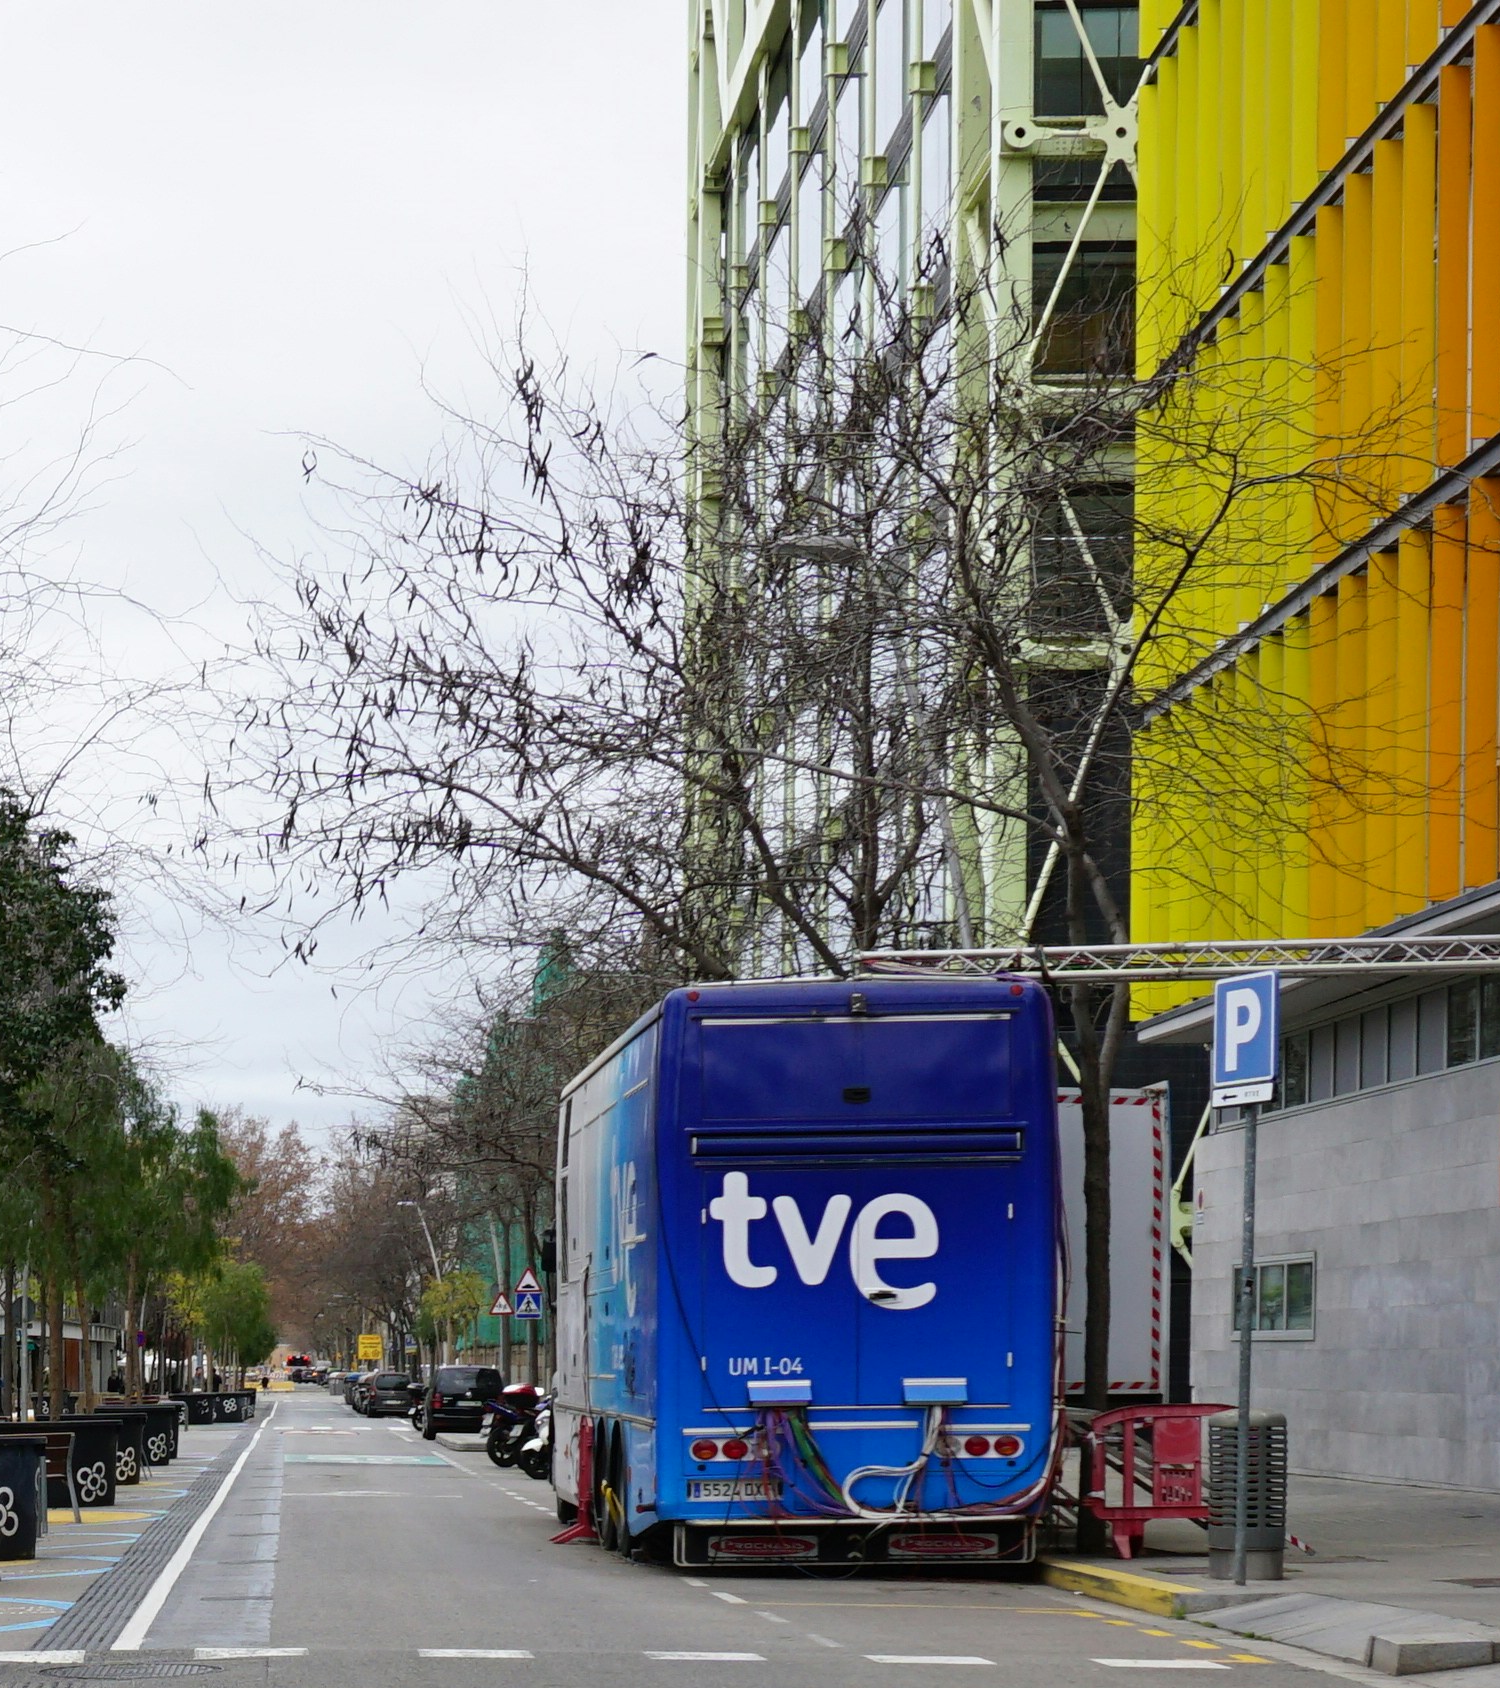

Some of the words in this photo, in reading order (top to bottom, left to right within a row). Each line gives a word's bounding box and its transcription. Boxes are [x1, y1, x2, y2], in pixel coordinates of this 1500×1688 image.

[1224, 987, 1261, 1073] P
[709, 1171, 940, 1310] tve
[728, 1356, 759, 1376] UM
[763, 1356, 804, 1376] I-04
[703, 1482, 741, 1497] 5524
